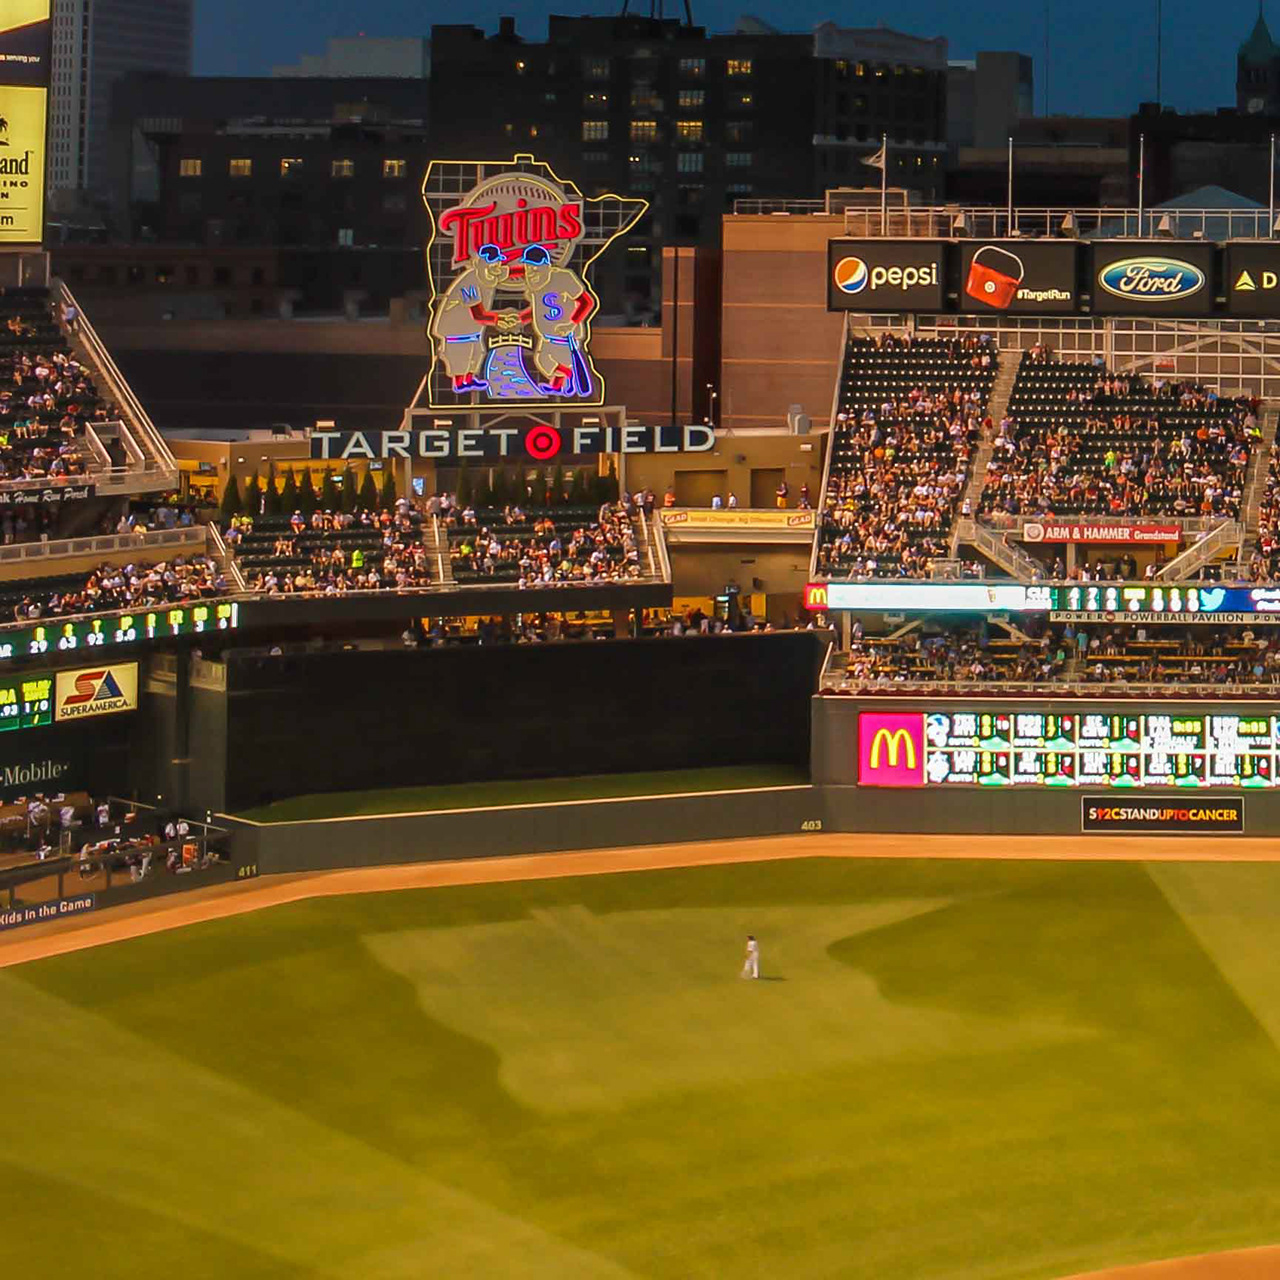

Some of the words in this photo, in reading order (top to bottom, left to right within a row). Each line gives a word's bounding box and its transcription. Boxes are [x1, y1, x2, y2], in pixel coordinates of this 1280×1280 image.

[440, 198, 580, 263] Twins
[870, 262, 938, 290] pepsi
[1118, 258, 1184, 294] Ford
[1016, 287, 1071, 303] #TargetRun
[311, 428, 518, 459] TARGET
[573, 424, 716, 453] FIELD
[789, 514, 811, 526] GLAD
[1046, 527, 1070, 539] ARM
[1072, 527, 1080, 539] &
[1084, 527, 1130, 540] HAMMER
[1134, 530, 1179, 541] Grandstand
[1123, 612, 1190, 622] POWERBALL
[1192, 613, 1244, 623] PAVILION
[87, 632, 104, 646] 92
[147, 625, 154, 638] 1
[172, 623, 179, 636] 1
[60, 699, 130, 718] SUPERAMERICA
[801, 820, 822, 831] 403
[238, 865, 257, 878] 411
[39, 905, 57, 917] the
[60, 899, 91, 913] Game
